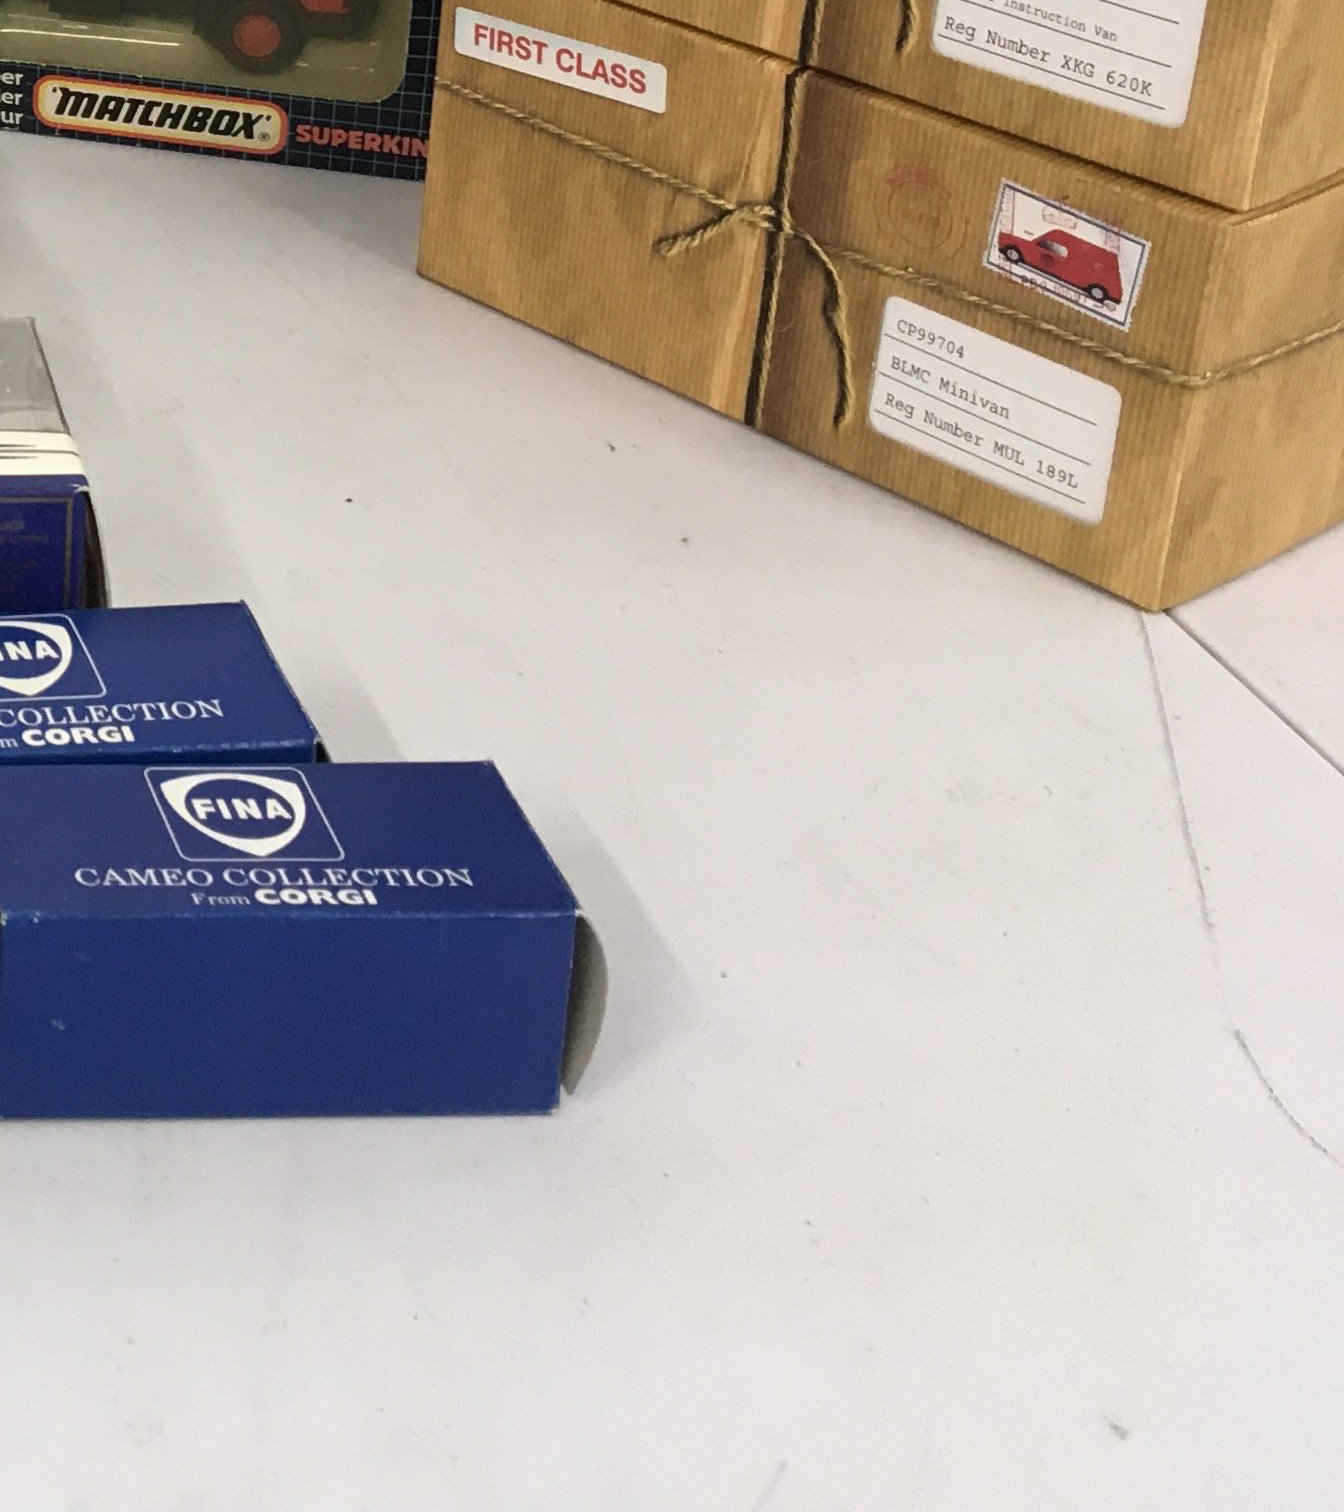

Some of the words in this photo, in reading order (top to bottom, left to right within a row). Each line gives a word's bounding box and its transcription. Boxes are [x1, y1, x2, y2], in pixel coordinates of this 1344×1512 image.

[1094, 25, 1117, 42] Van
[472, 24, 548, 68] FIRST
[554, 47, 646, 95] CLASS
[945, 16, 976, 40] Reg
[986, 31, 1051, 62] Number
[1060, 55, 1095, 78] XKG
[1106, 71, 1153, 96] 620K
[897, 319, 965, 358] CP99704
[891, 356, 930, 384] BLMC
[939, 377, 1009, 419] Minivan
[885, 393, 914, 418] Reg
[924, 410, 984, 447] Number
[993, 441, 1024, 466] MUL
[1036, 459, 1078, 488] 189L
[22, 727, 135, 746] CORGI
[191, 798, 292, 820] FINA
[74, 868, 212, 887] CAMEO
[223, 868, 474, 887] COLLECTION
[191, 892, 250, 906] From
[255, 889, 378, 905] CORGI
